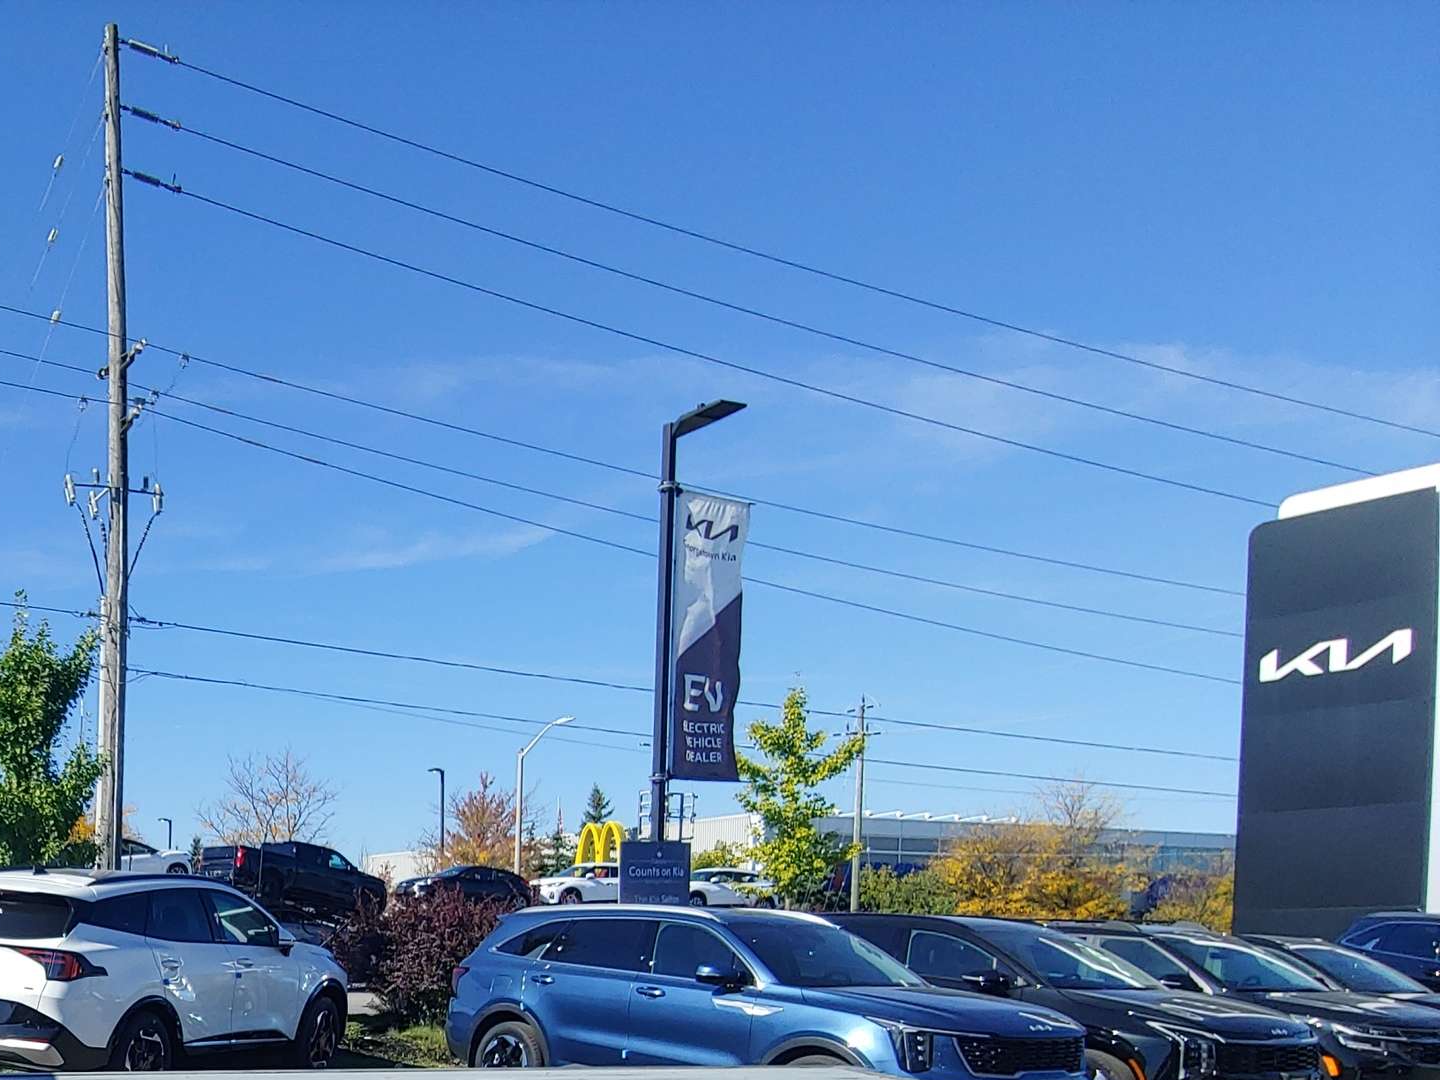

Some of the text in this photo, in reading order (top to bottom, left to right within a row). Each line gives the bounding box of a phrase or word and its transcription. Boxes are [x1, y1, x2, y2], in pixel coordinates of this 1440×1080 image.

[1259, 628, 1413, 683] KIA
[683, 673, 723, 713] EV
[683, 720, 725, 734] ELECTRIC
[685, 735, 722, 749] VEHICLE
[685, 749, 722, 763] DEALER
[628, 865, 660, 877] Counts
